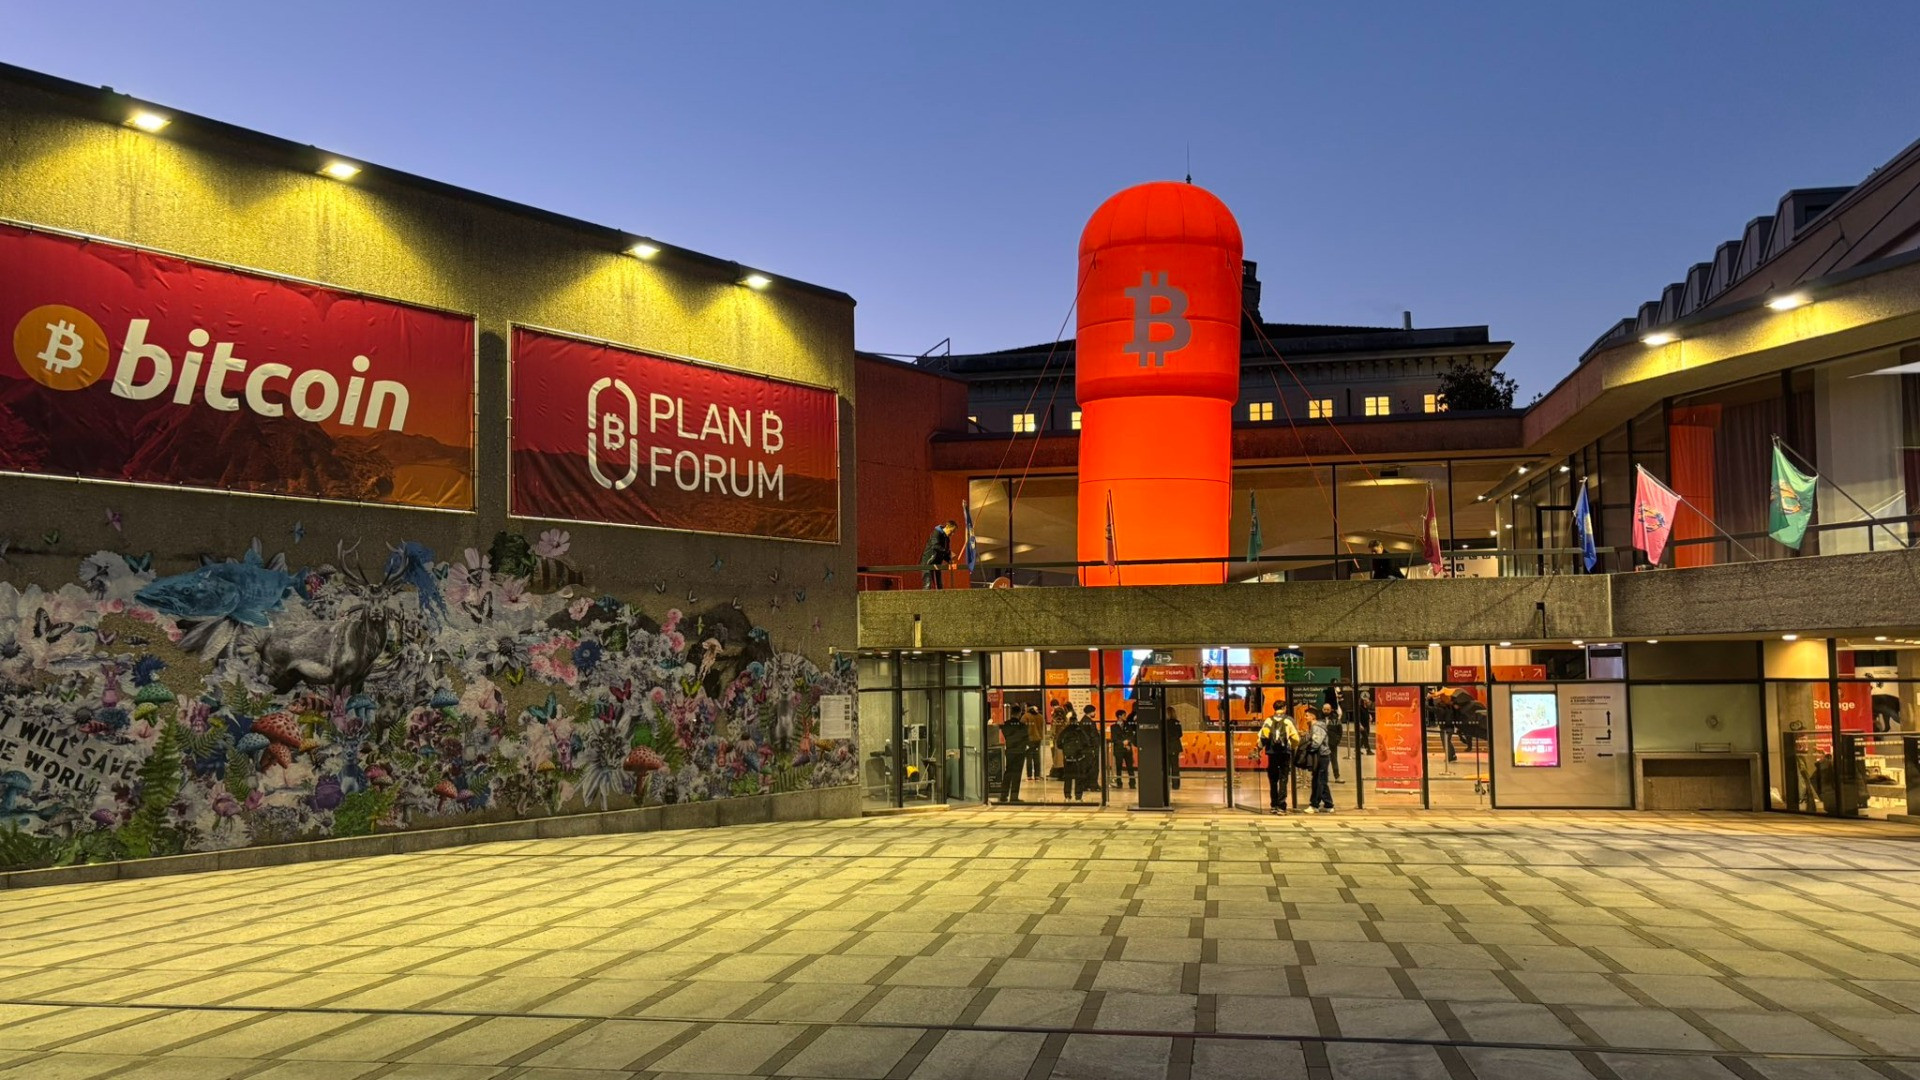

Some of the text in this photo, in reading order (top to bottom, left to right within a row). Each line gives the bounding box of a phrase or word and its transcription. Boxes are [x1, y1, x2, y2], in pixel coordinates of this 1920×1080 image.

[110, 318, 410, 432] bitcoin
[650, 393, 751, 448] PLAN
[650, 446, 784, 501] FORUM
[1813, 700, 1855, 711] Stoge
[19, 720, 69, 758] WILL
